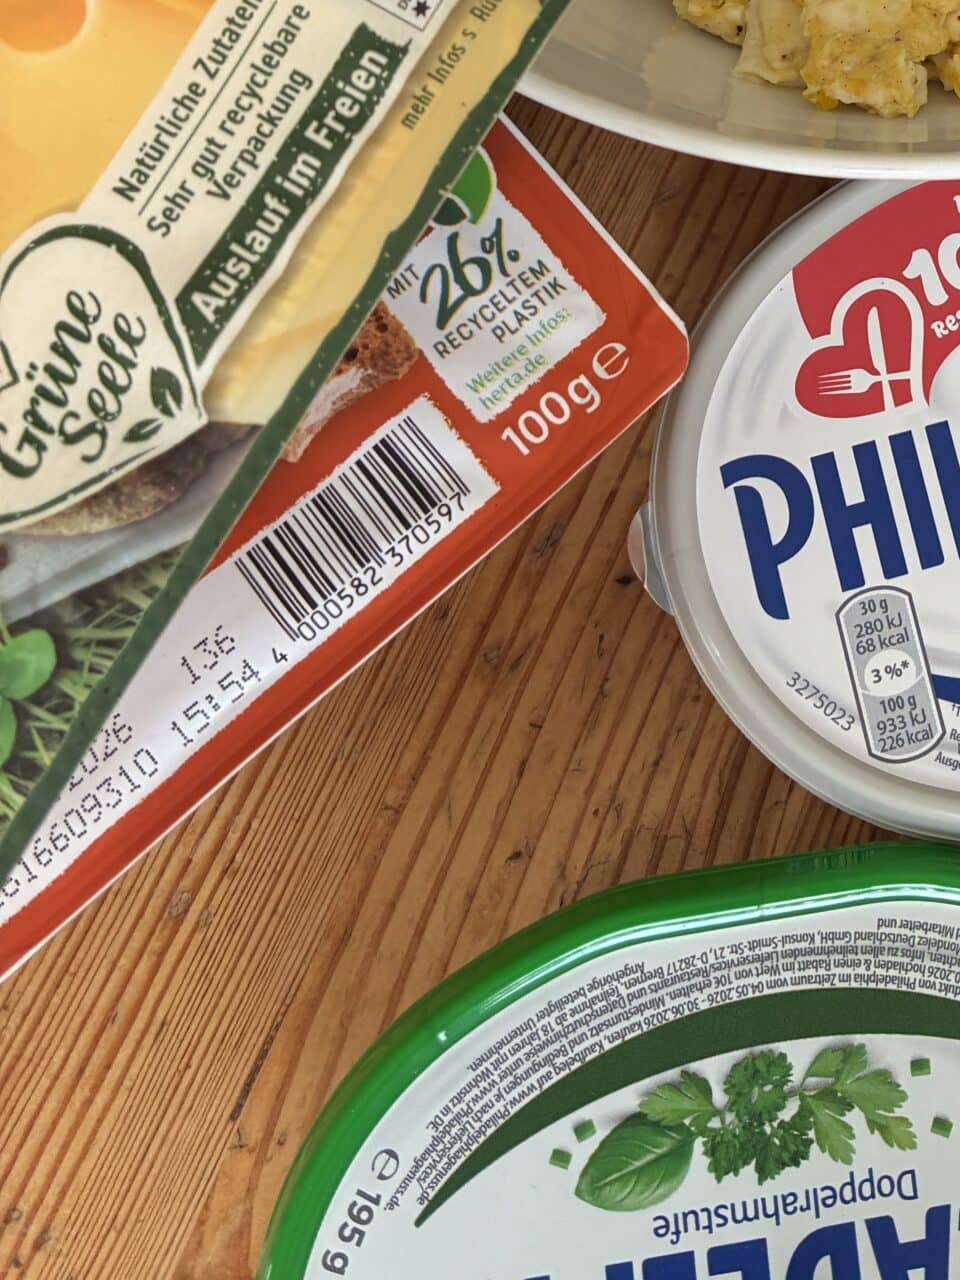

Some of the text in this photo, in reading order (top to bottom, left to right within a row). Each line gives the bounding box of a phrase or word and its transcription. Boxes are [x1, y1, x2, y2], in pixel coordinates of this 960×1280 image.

[402, 85, 435, 131] mehr
[428, 43, 466, 84] Infos
[112, 81, 207, 204] Natürliche
[147, 3, 311, 239] Sehr gut recyclebare
[205, 68, 313, 203] Verpackung
[191, 49, 390, 322] Auslauf im Freien
[386, 217, 521, 330] MIT 26%
[433, 259, 550, 359] RECYCELTEM
[491, 276, 567, 344] PLASTIK
[466, 307, 572, 395] Weitere Infos:
[0, 290, 101, 479] Grüne
[58, 312, 146, 464] Seele
[478, 353, 547, 411] herta.de
[272, 492, 466, 664] 4 000582 370597
[859, 599, 889, 616] 30 g
[181, 625, 235, 685] 136
[854, 612, 903, 639] 280 kJ
[855, 627, 910, 655] 68 kcal
[171, 659, 261, 747] 15:54
[786, 671, 855, 732] 3275023
[876, 708, 927, 736] 933 kJ
[880, 695, 917, 715] 100 g
[878, 724, 934, 753] 226 kcal
[877, 918, 898, 930] und
[898, 919, 955, 940] Mitarbeiter
[535, 989, 588, 1021] beteiligter
[587, 961, 645, 994] Angehörige
[466, 1017, 537, 1072] Unternehmen.
[338, 1189, 382, 1248] 195
[653, 1169, 920, 1244] Doppelrahmstufe
[321, 1248, 349, 1276] g
